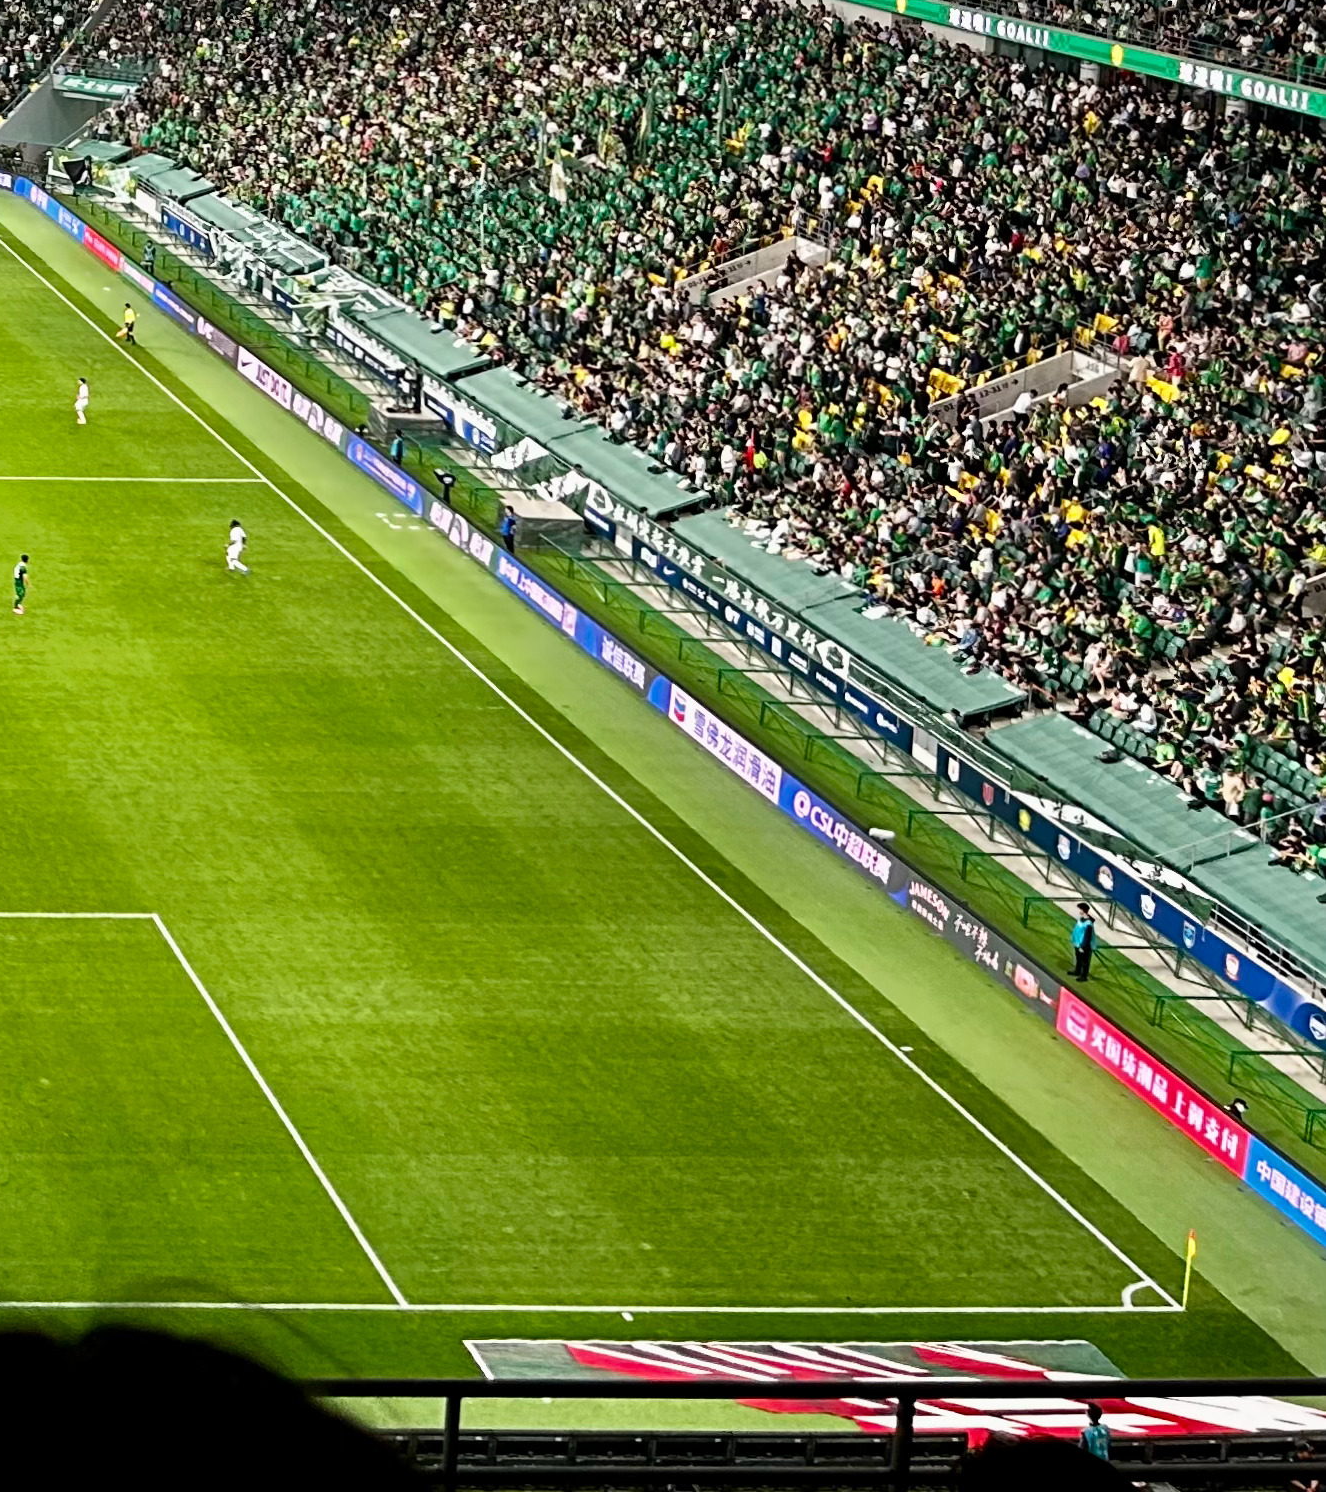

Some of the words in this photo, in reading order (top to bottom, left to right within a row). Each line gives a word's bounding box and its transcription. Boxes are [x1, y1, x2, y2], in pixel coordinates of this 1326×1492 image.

[693, 709, 776, 796] 雪佛龙润滑油
[909, 881, 951, 921] JAMESON
